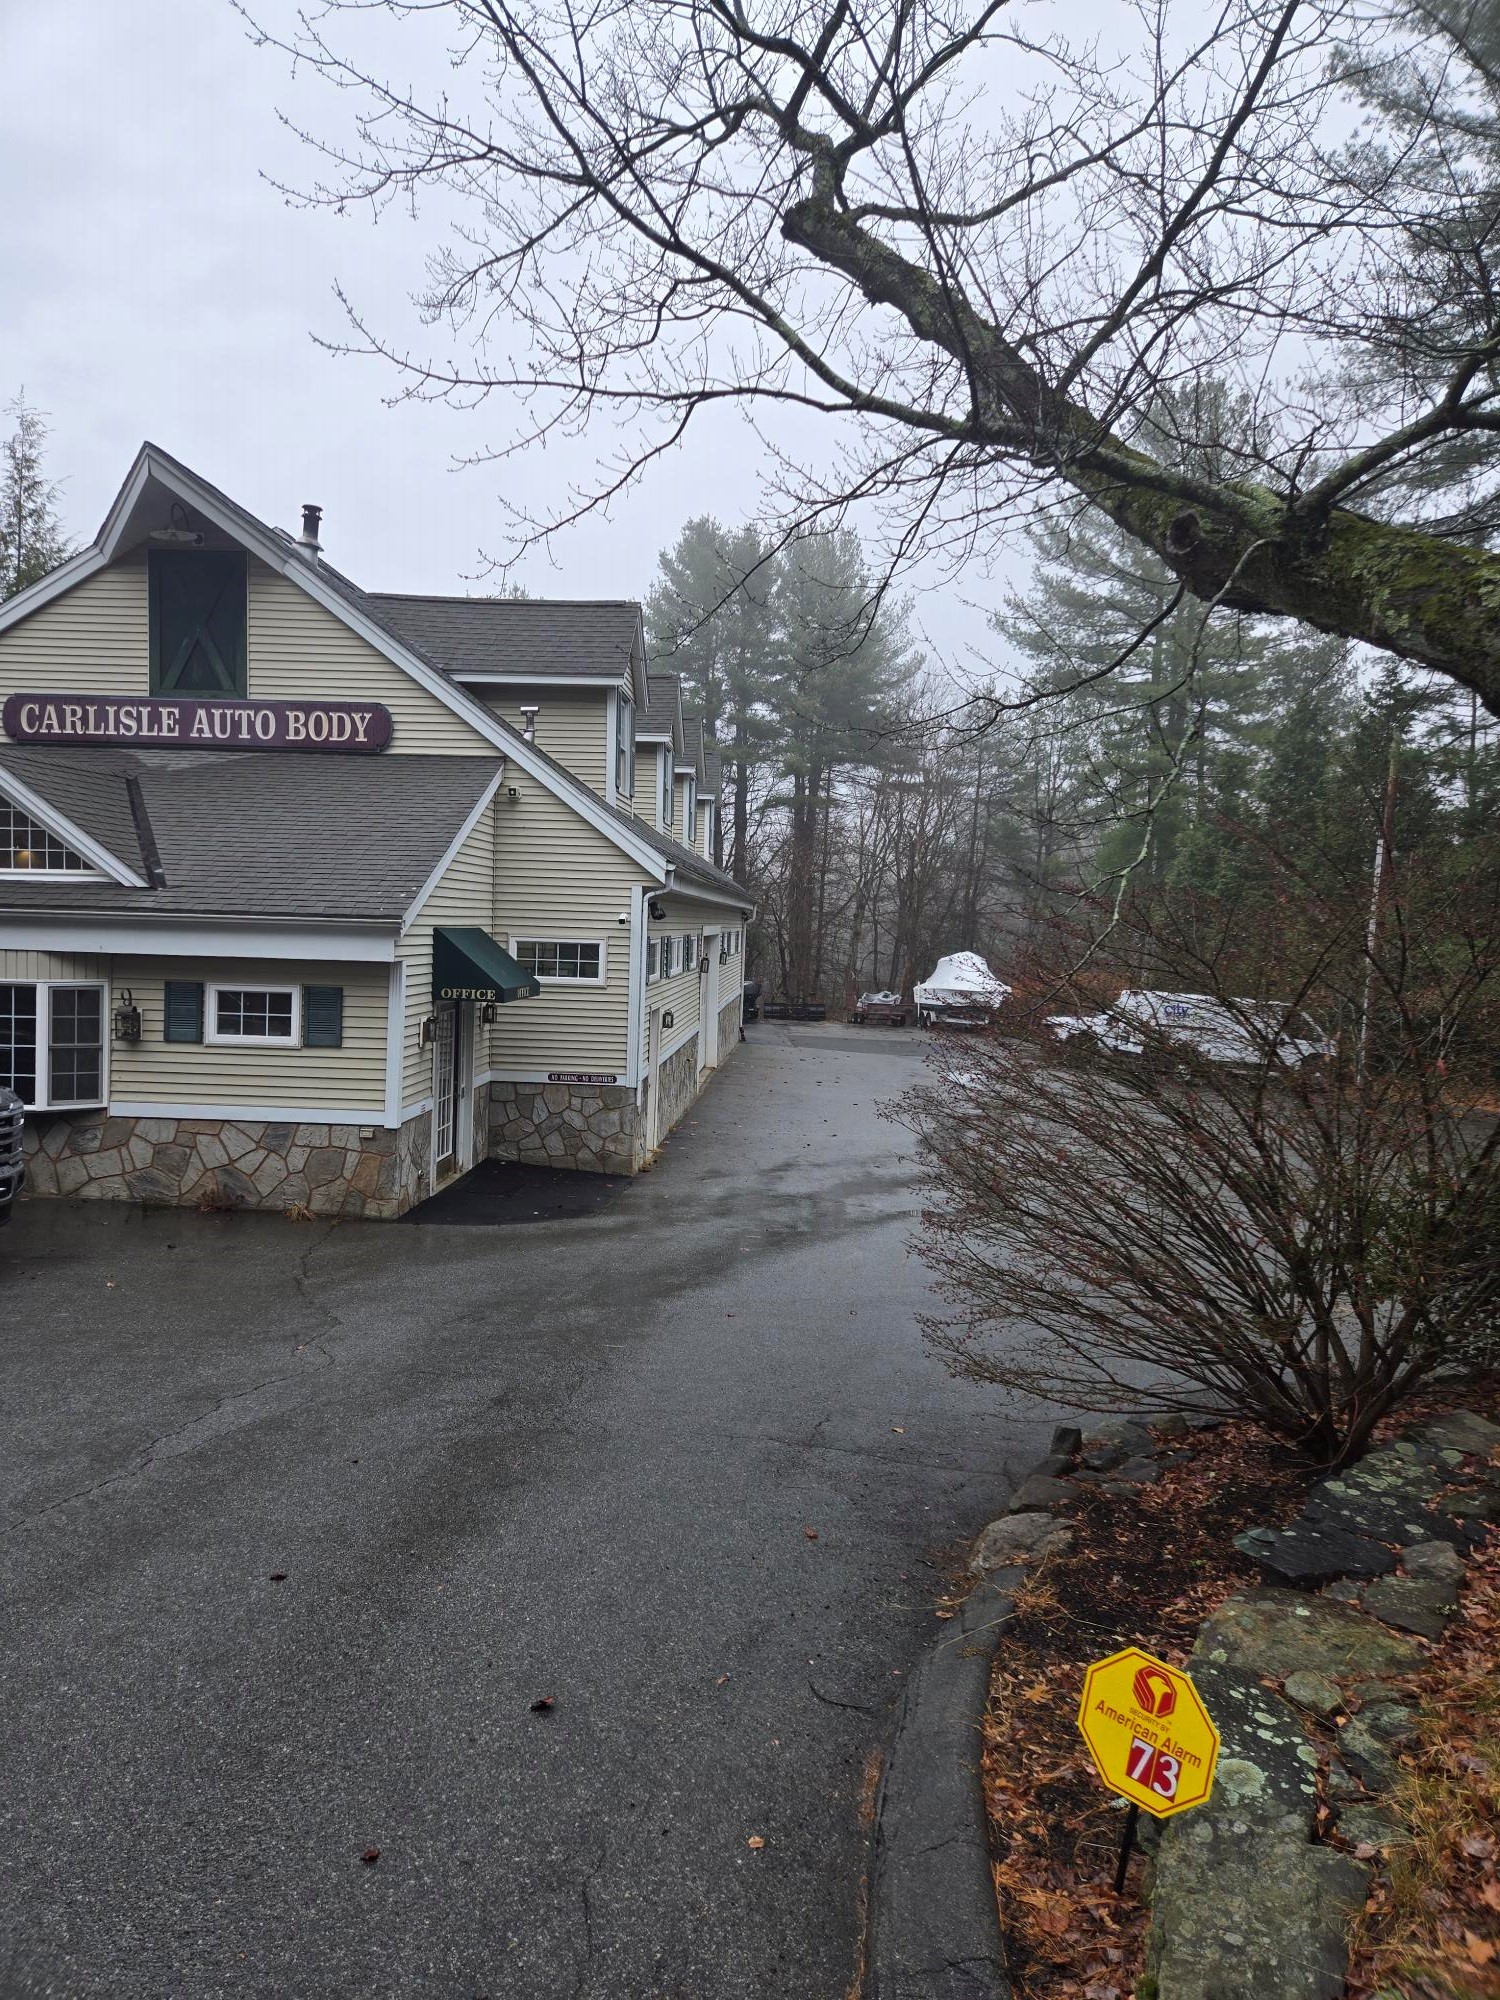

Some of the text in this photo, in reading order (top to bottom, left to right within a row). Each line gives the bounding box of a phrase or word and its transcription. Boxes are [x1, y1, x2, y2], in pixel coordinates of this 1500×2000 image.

[20, 703, 373, 742] CARLISLE AUTO BODY
[440, 987, 496, 1000] OFFICE
[1095, 1700, 1201, 1769] American Alarm
[1129, 1707, 1160, 1727] SECURITY
[1160, 1724, 1171, 1733] BY
[1131, 1738, 1179, 1797] 73
